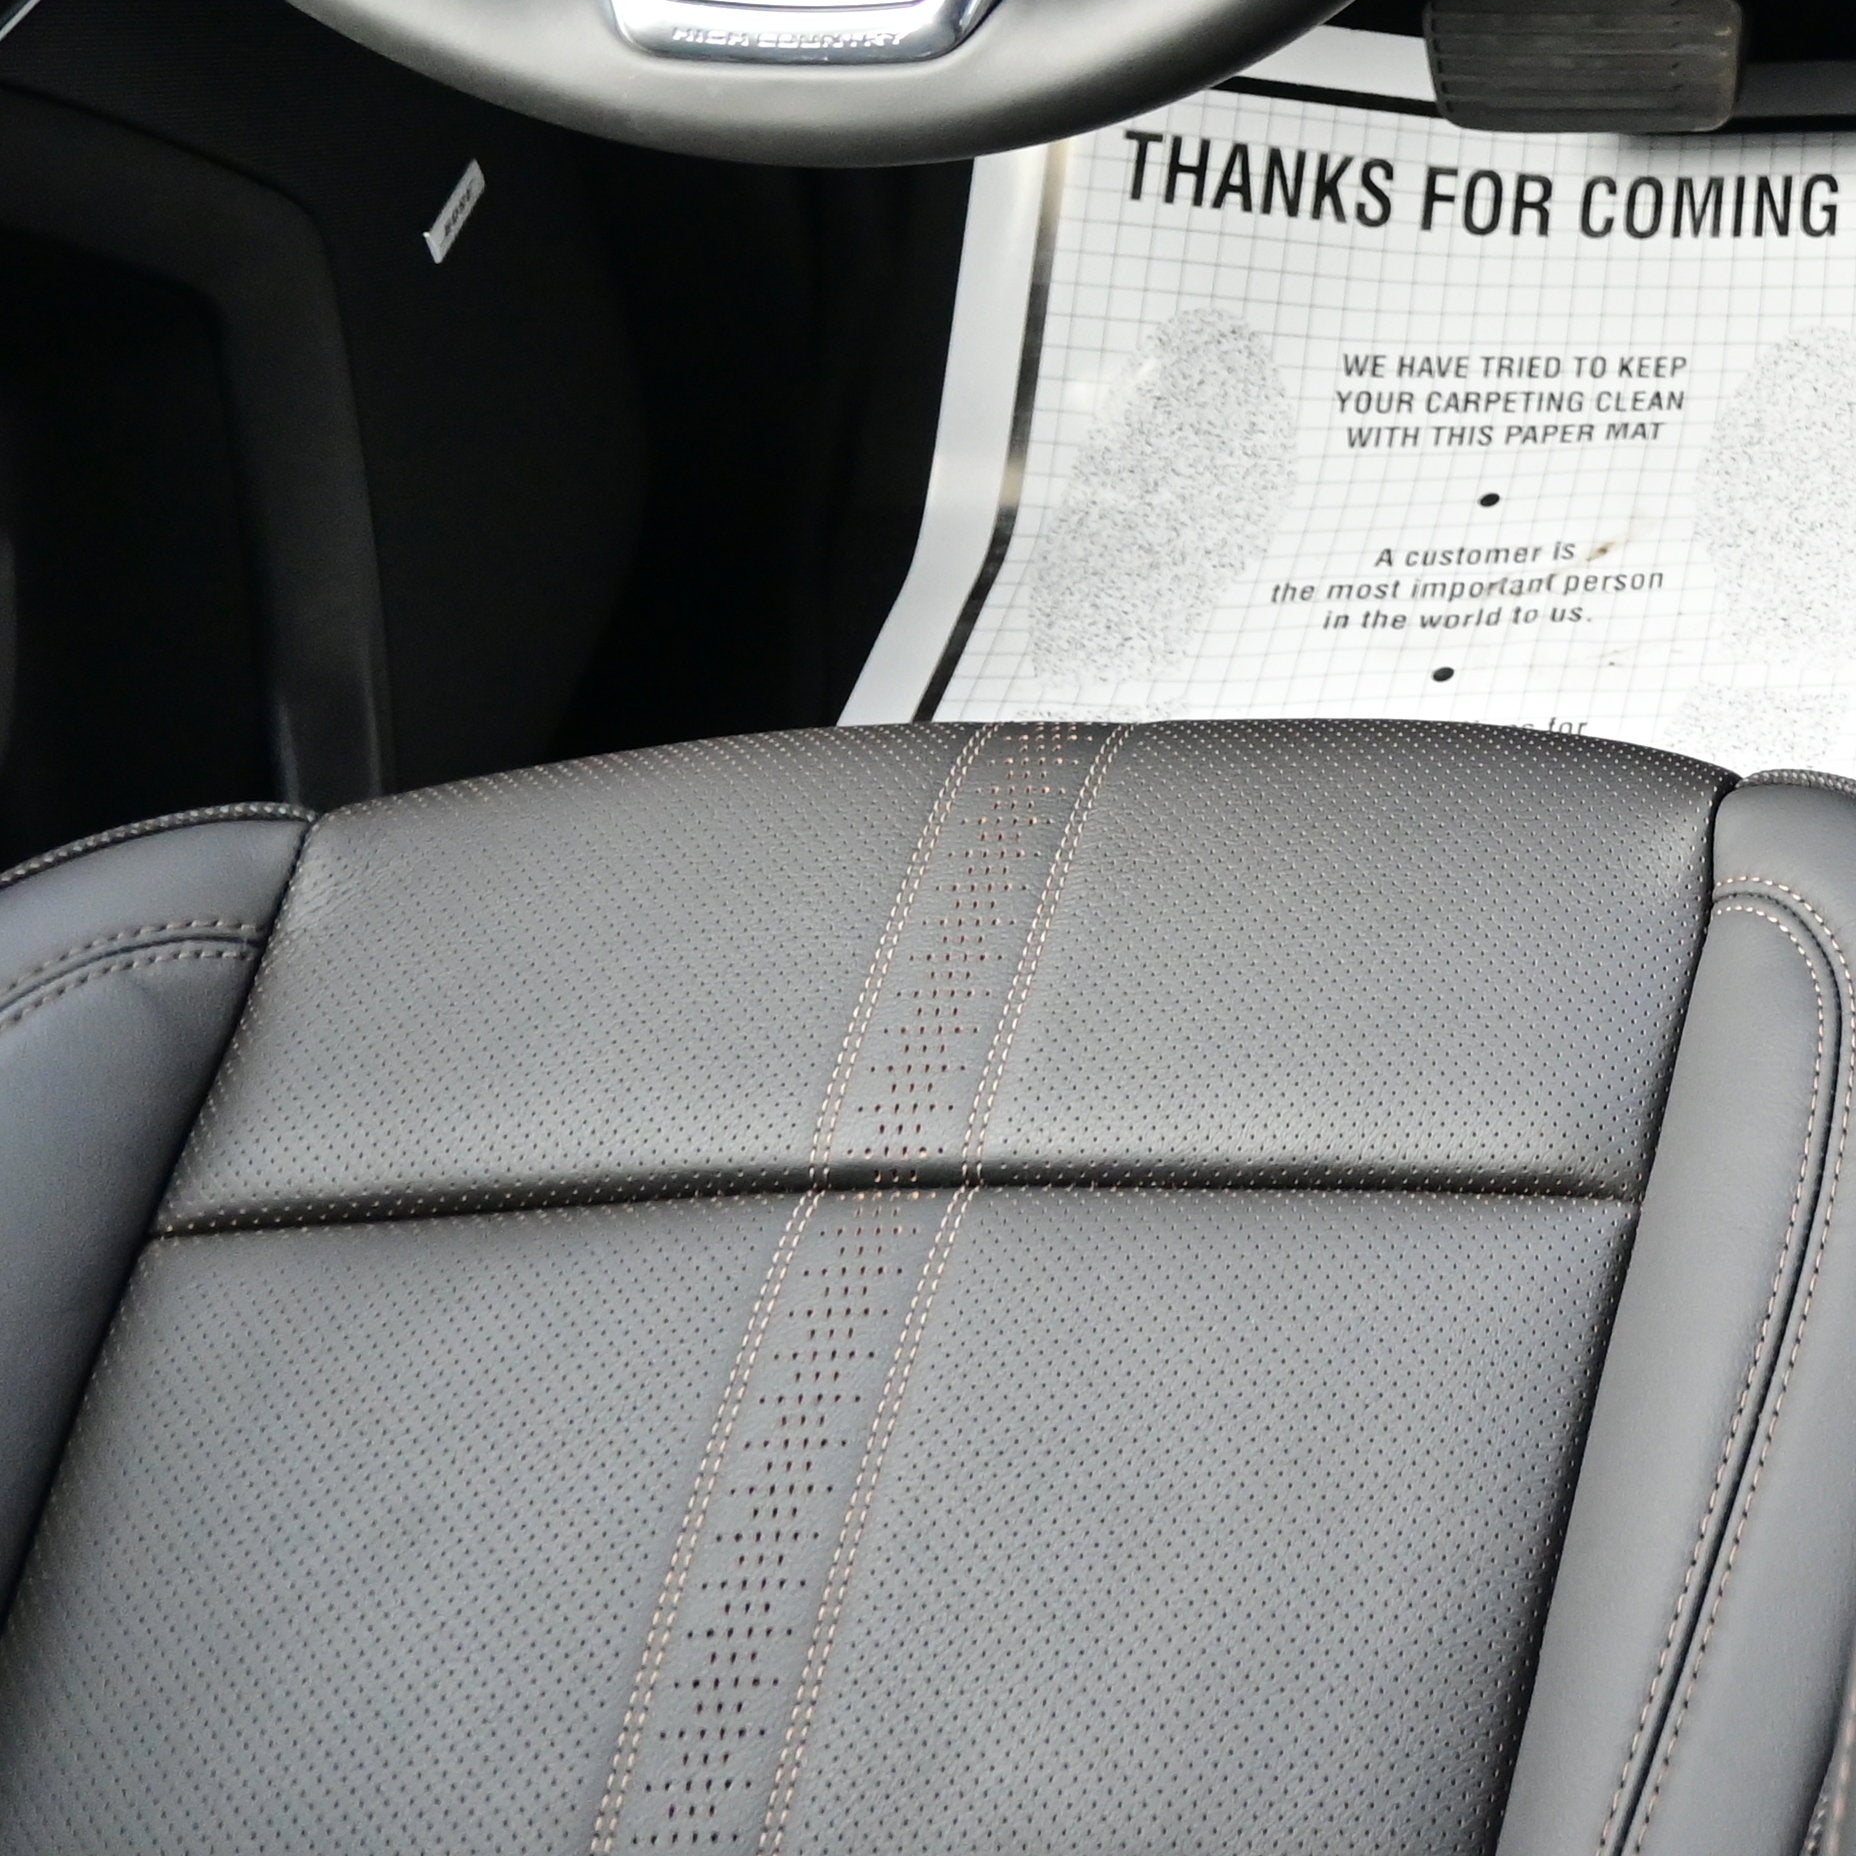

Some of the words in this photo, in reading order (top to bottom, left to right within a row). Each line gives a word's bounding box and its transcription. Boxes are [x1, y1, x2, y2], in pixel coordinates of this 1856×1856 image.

[1124, 129, 1394, 228] THANKS
[1421, 165, 1552, 237] FOR
[1580, 173, 1839, 239] COMING
[1343, 353, 1387, 378] WE
[1396, 355, 1470, 379] HAVE
[1481, 356, 1561, 379] TRIED
[1574, 356, 1607, 379] TO
[1618, 356, 1688, 379] KEEP
[1335, 390, 1414, 414] YOUR
[1425, 390, 1585, 414] CARPETING
[1595, 390, 1685, 413] CLEAN
[1347, 426, 1420, 449] WITH
[1432, 425, 1494, 447] THIS
[1504, 423, 1594, 445] PAPER
[1605, 421, 1665, 441] MAT
[1374, 547, 1393, 567] A
[1405, 546, 1542, 567] customer
[1552, 541, 1576, 561] is
[1270, 582, 1315, 604] the
[1326, 579, 1402, 601] most
[1411, 572, 1555, 603] important
[1563, 570, 1664, 596] person
[1322, 610, 1349, 630] in
[1361, 609, 1407, 630] the
[1419, 607, 1502, 629] world
[1512, 606, 1538, 625] to
[1551, 606, 1593, 624] us.
